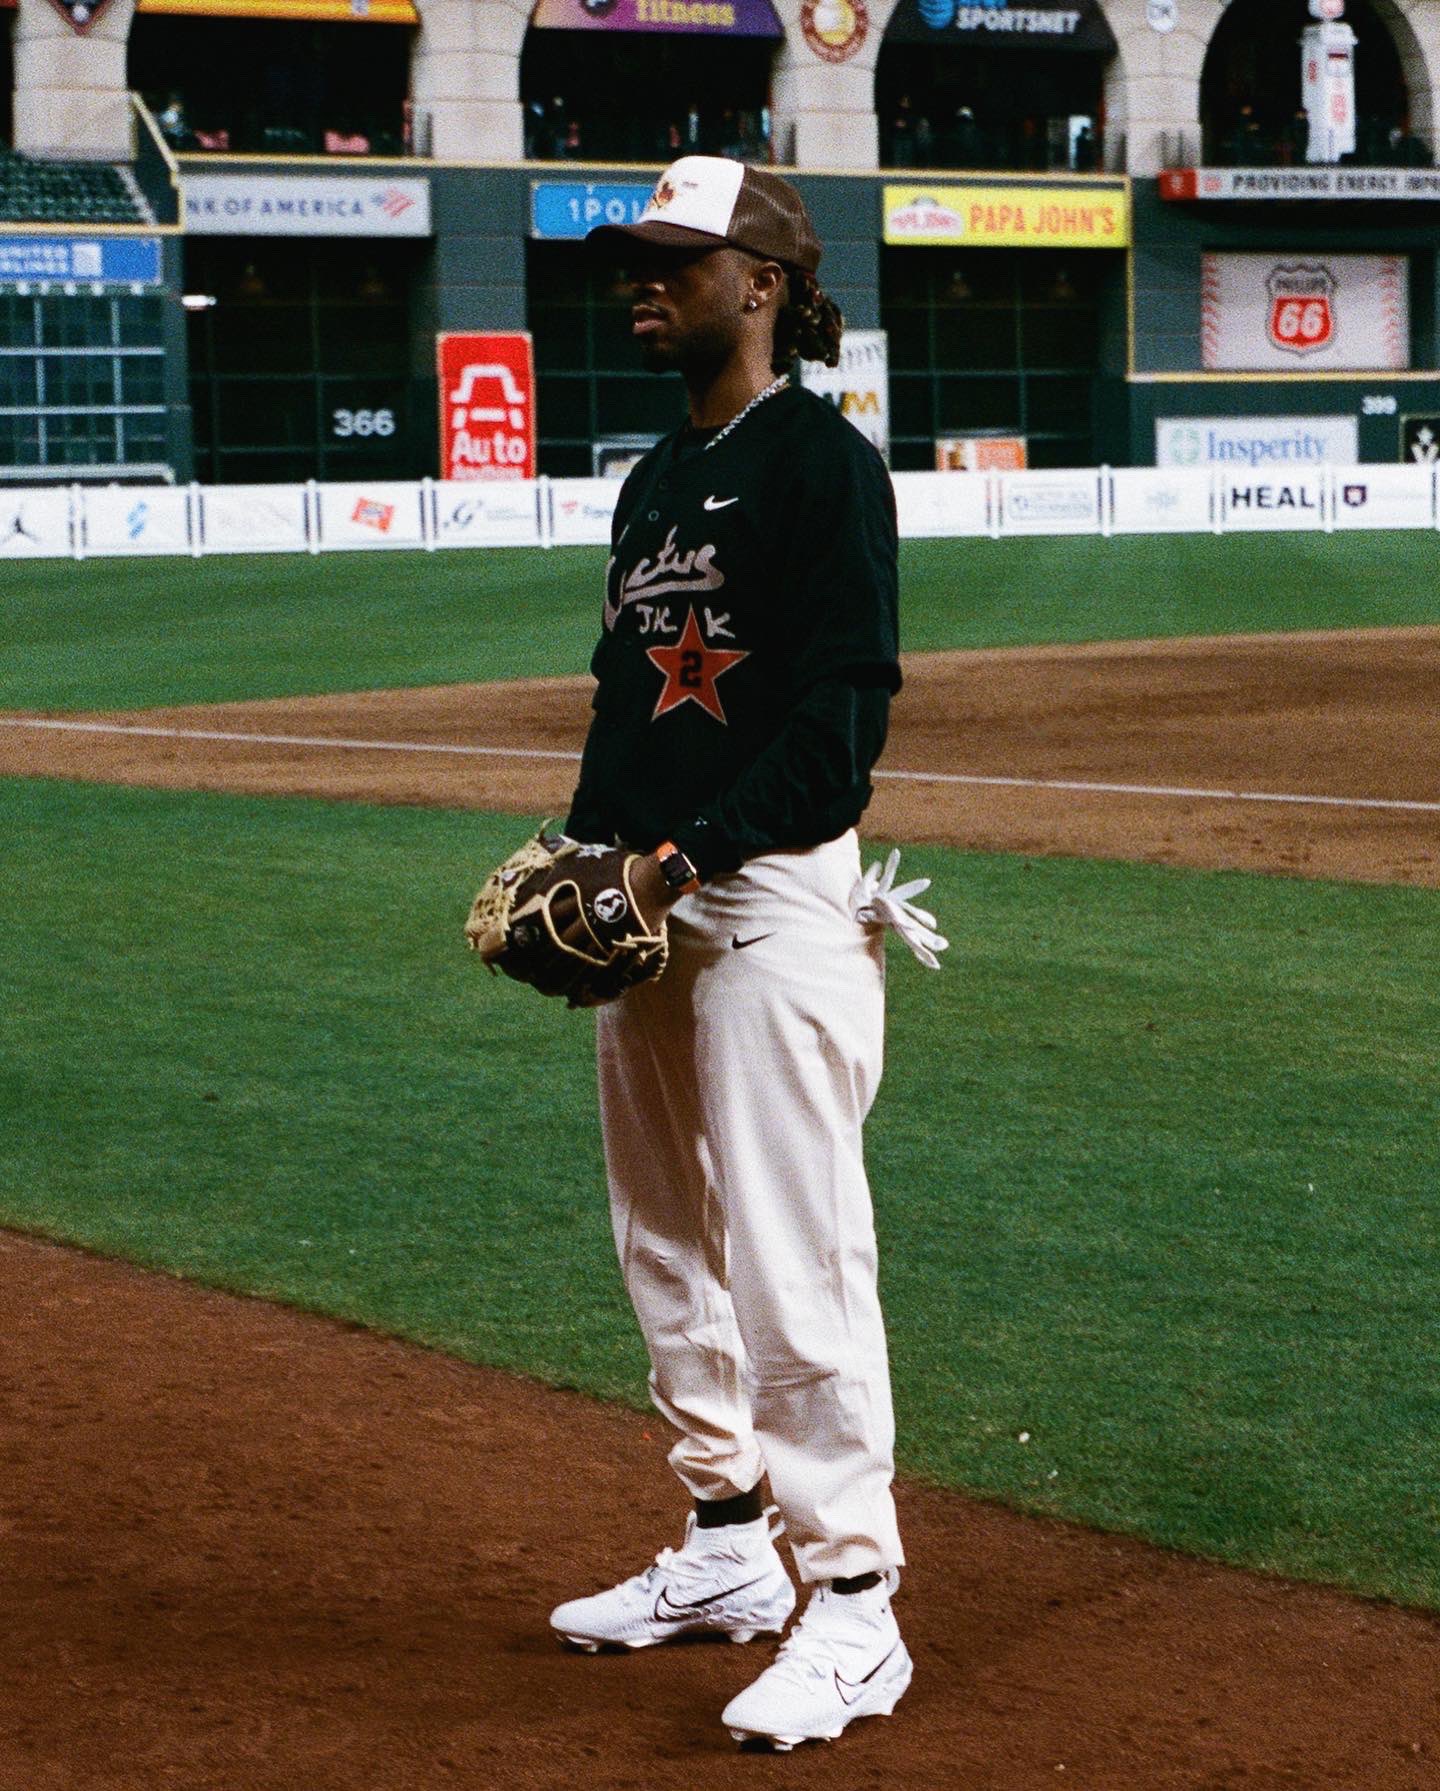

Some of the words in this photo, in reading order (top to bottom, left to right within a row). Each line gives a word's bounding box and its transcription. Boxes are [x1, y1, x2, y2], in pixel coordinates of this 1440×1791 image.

[957, 7, 1079, 33] SPORTSNET
[1232, 174, 1330, 191] PROVIDING
[223, 199, 251, 216] OF
[259, 198, 364, 217] AMERICA
[969, 204, 1026, 233] PAPA
[1033, 205, 1116, 235] JOHN'S
[1279, 302, 1324, 337] 66
[333, 408, 395, 437] 366
[452, 430, 526, 464] Auto
[1207, 430, 1326, 467] Insperity
[1231, 486, 1315, 509] HEAL
[679, 651, 704, 688] 2
